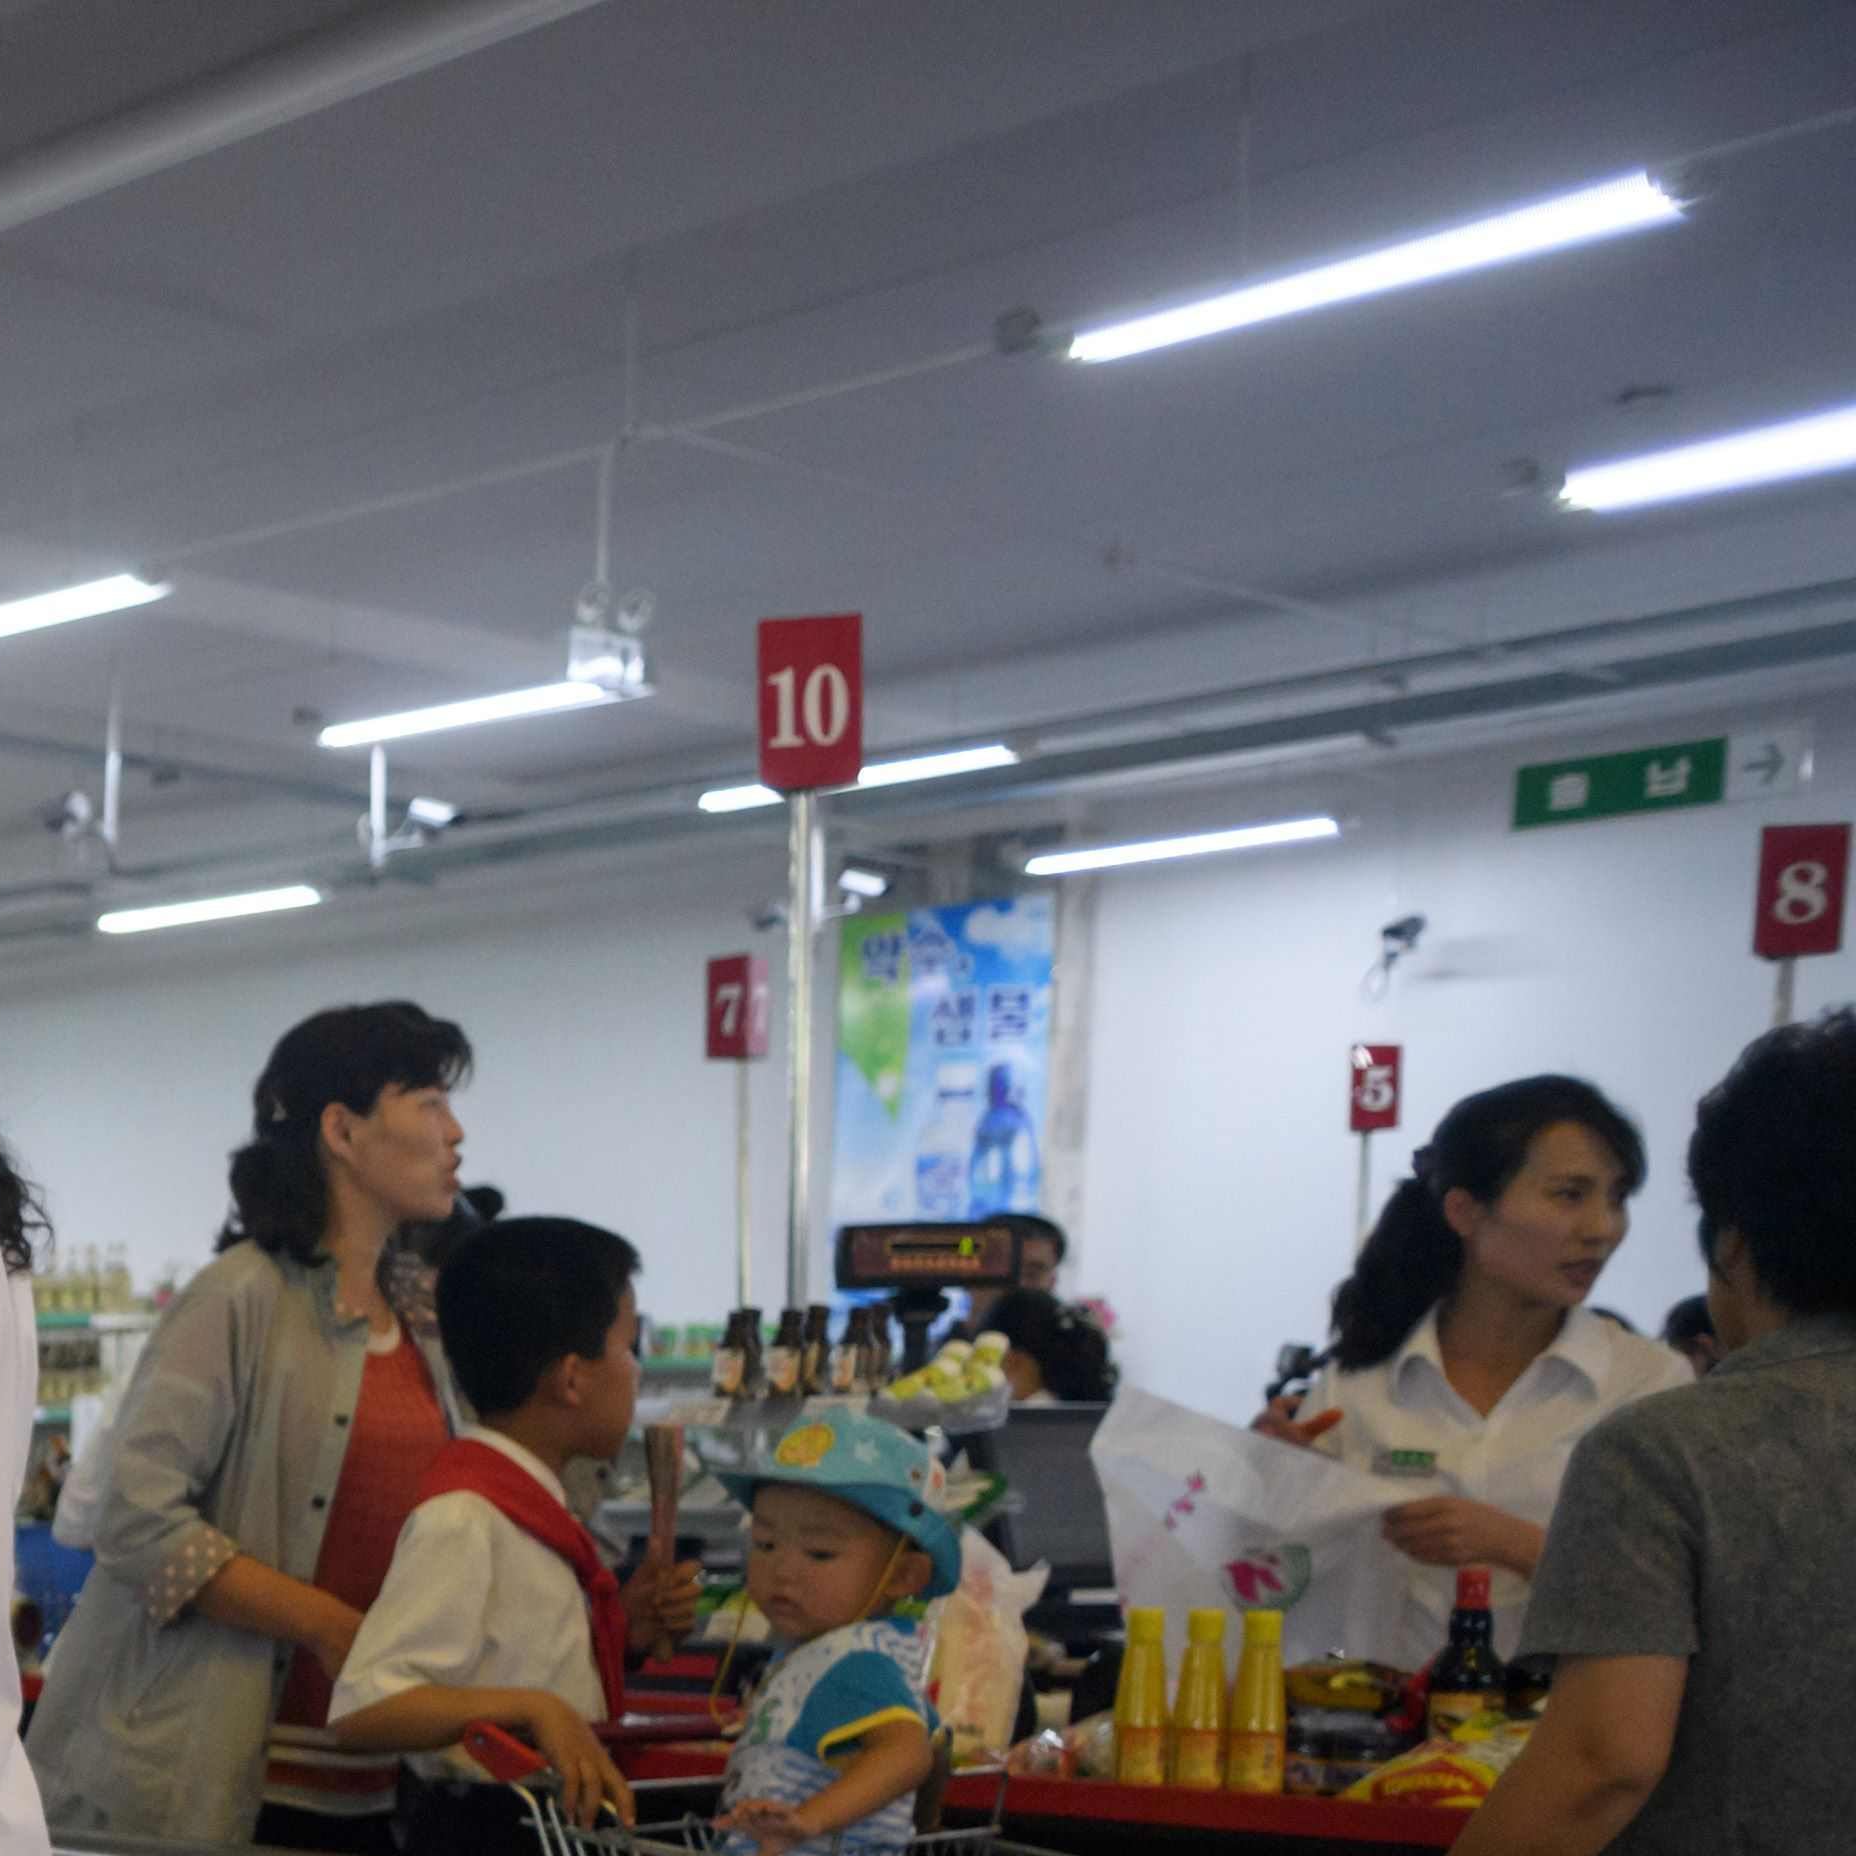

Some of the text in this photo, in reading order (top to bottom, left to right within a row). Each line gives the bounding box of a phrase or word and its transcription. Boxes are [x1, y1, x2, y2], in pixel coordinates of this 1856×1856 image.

[767, 663, 850, 749] 10
[1774, 860, 1829, 926] 8
[713, 982, 742, 1036] 7
[1359, 1065, 1394, 1112] 5
